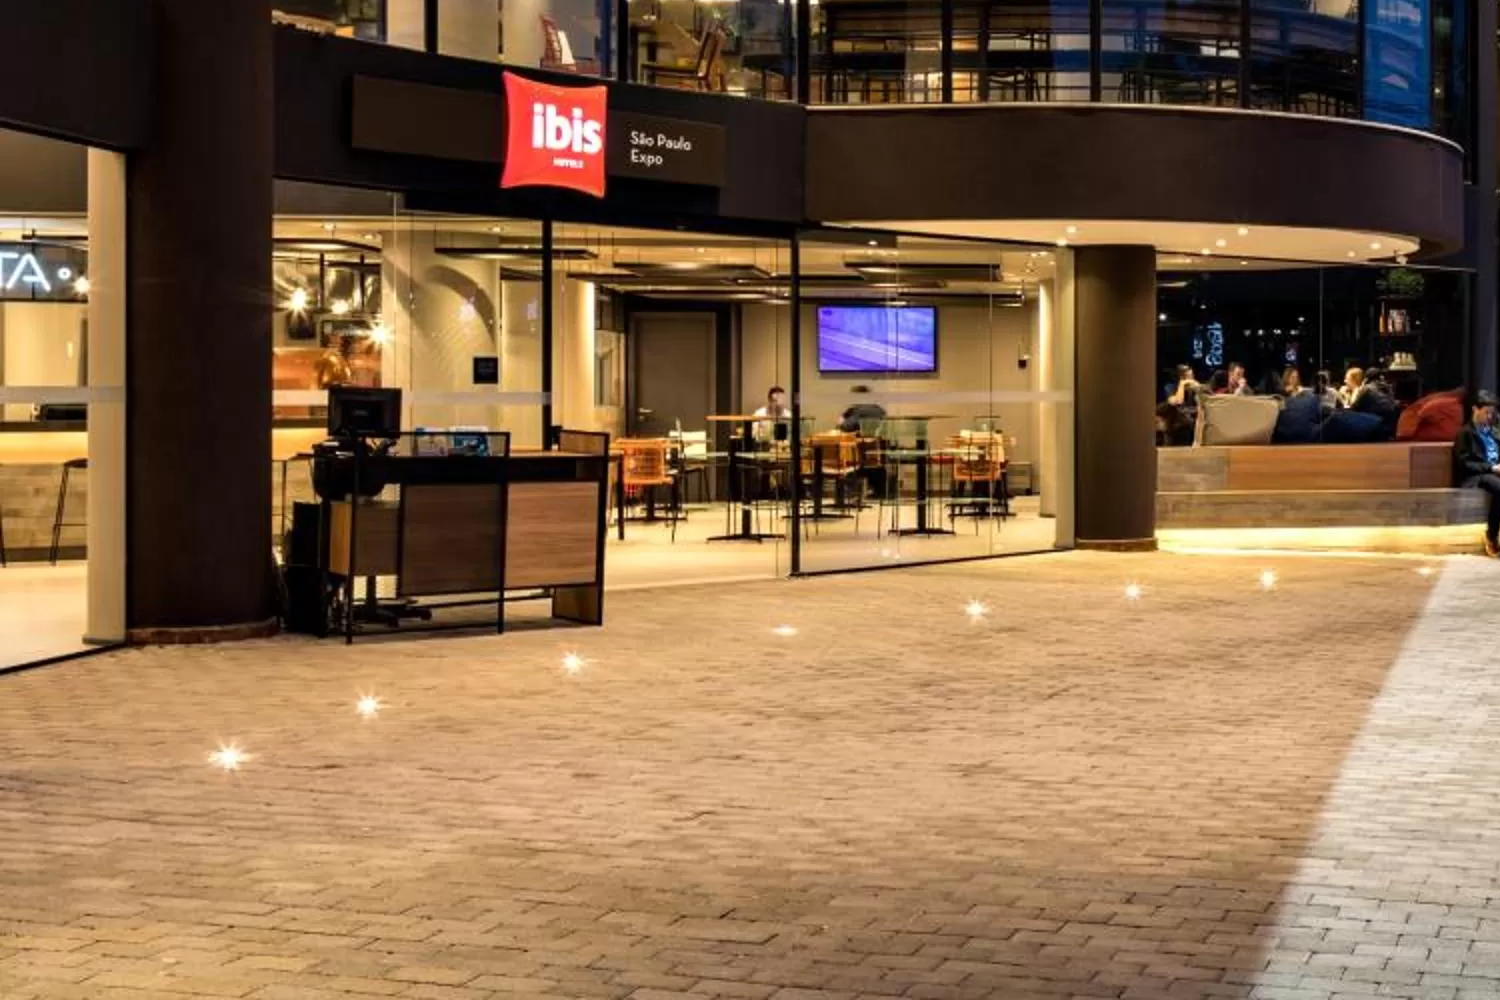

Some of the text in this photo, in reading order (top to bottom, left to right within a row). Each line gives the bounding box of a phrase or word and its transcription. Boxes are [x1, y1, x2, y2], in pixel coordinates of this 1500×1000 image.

[532, 103, 603, 154] ibis
[630, 131, 692, 151] São Paulo
[630, 150, 663, 167] Expo
